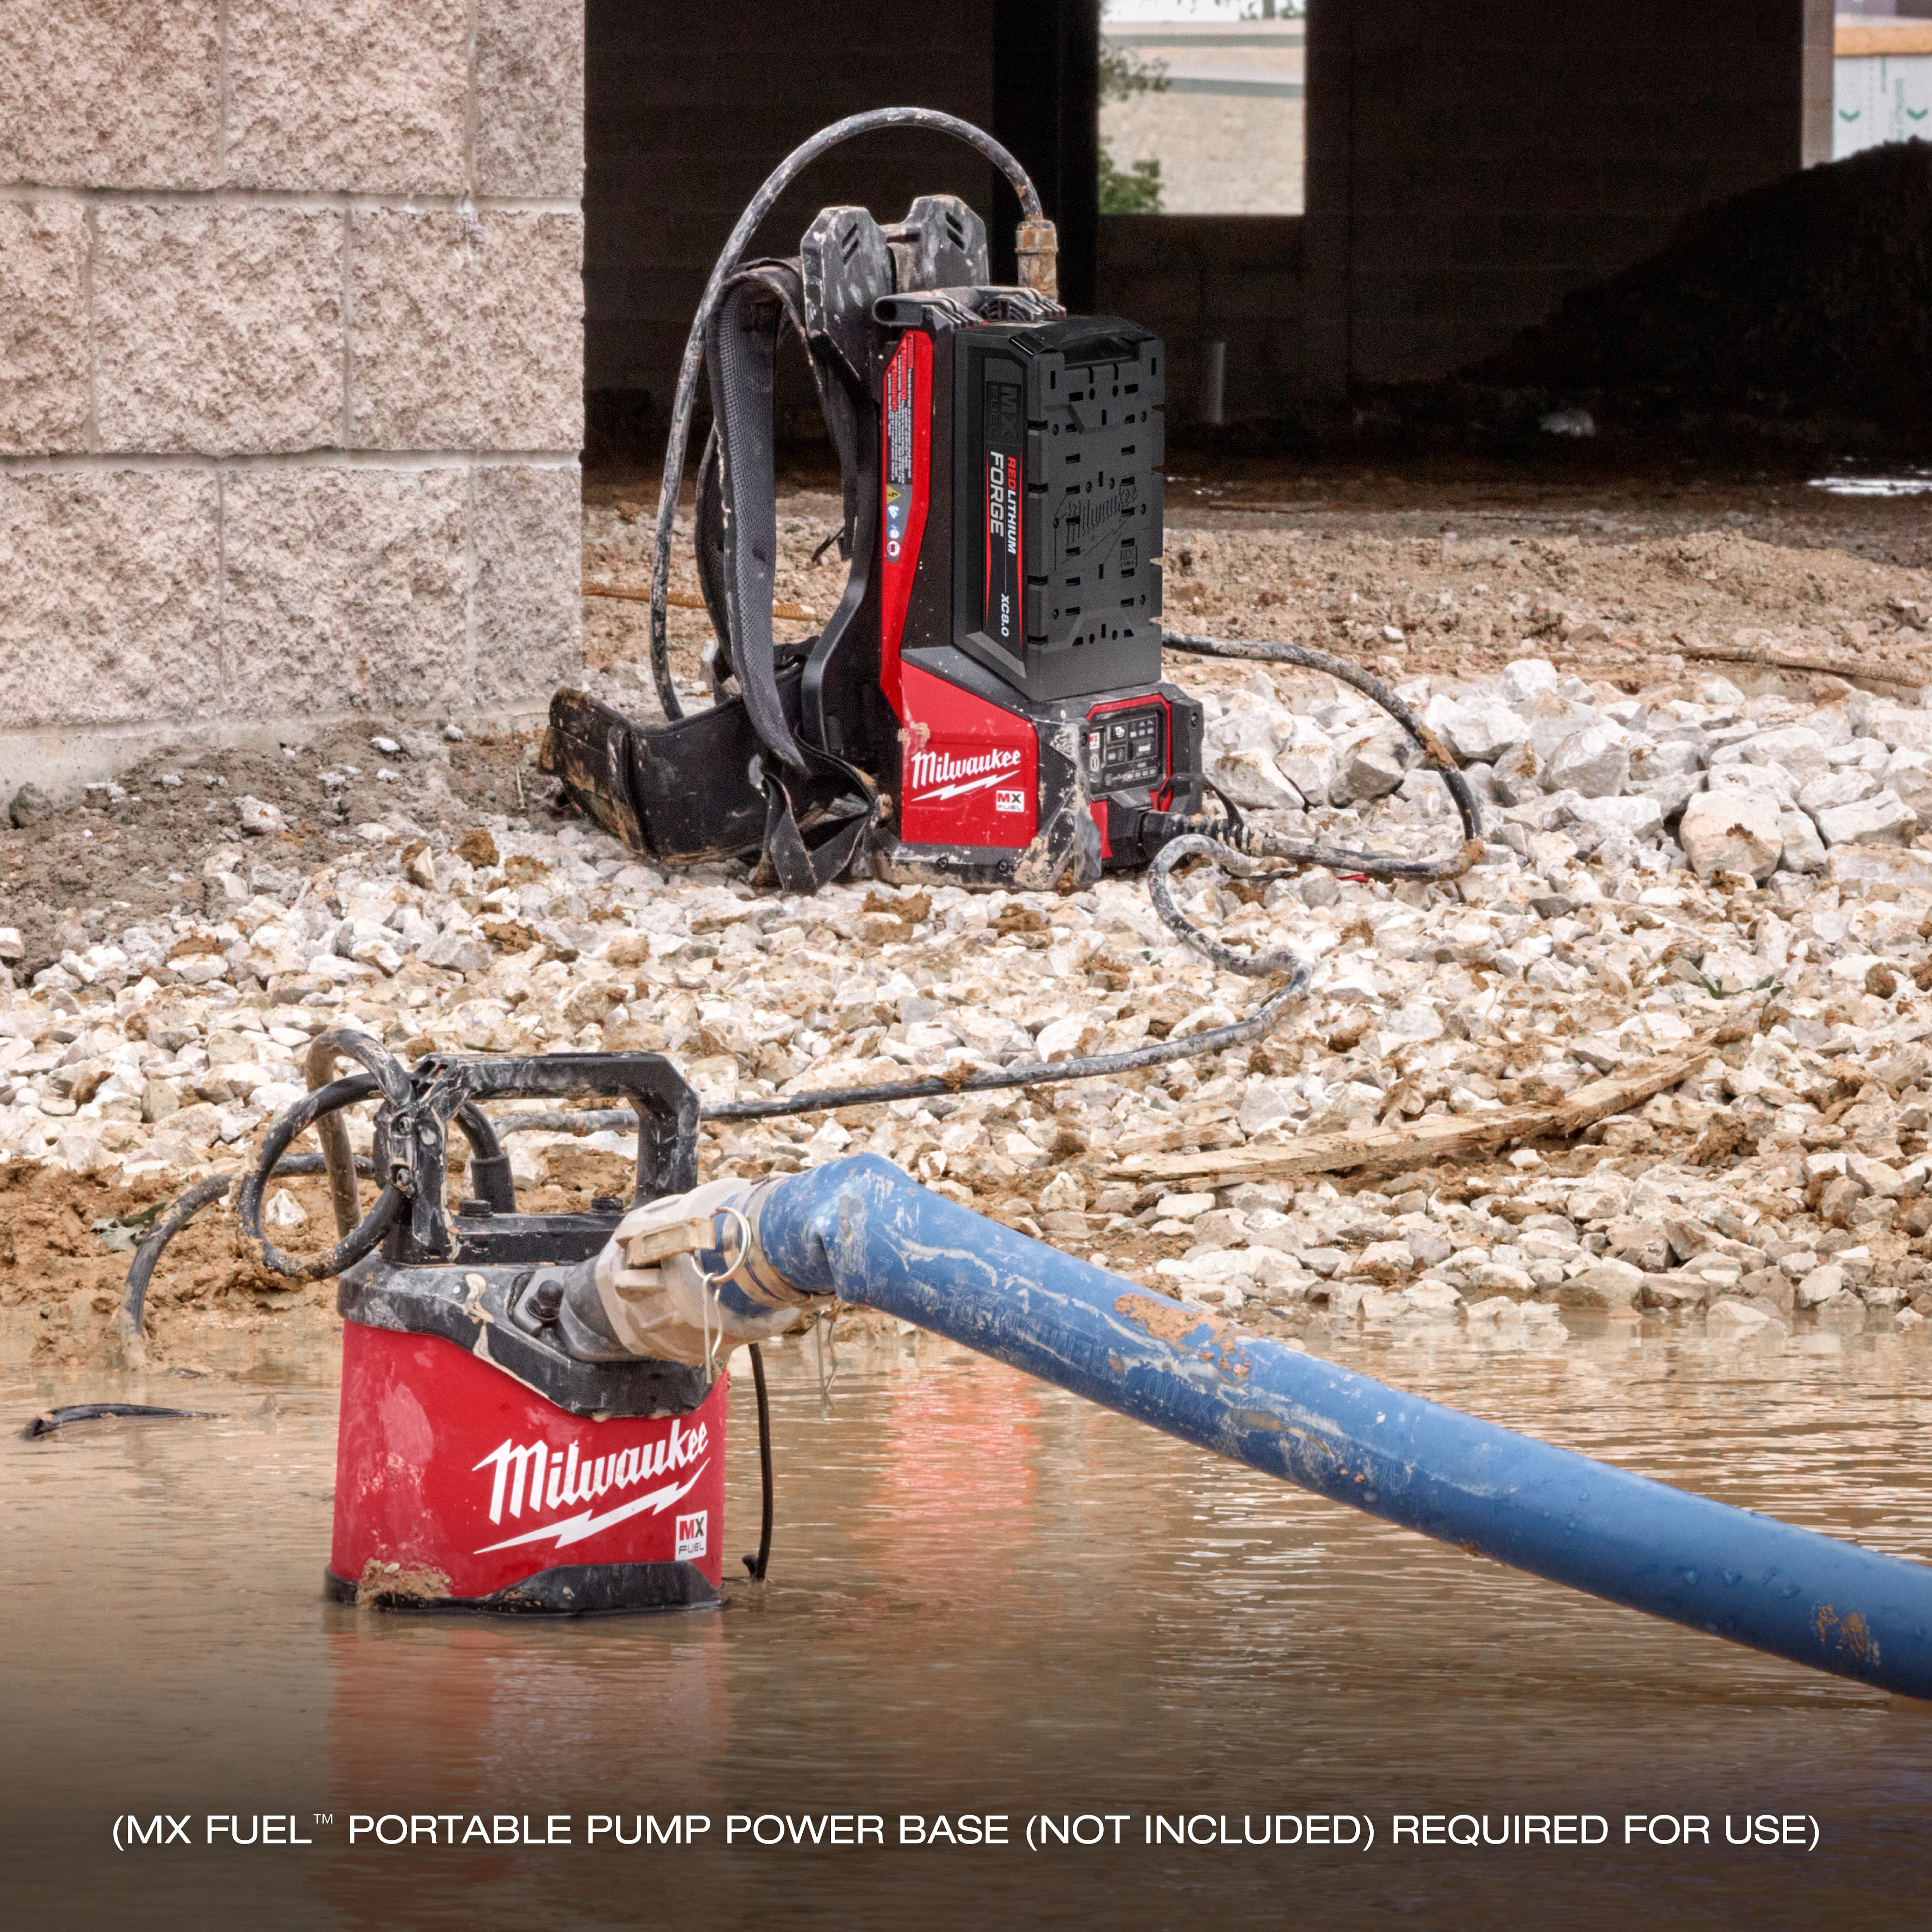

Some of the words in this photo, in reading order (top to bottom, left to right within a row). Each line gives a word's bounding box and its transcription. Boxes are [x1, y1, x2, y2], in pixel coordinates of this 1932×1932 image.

[1001, 386, 1017, 440] MX
[989, 451, 1004, 537] FORGE
[1007, 456, 1017, 554] REDLITHIUM
[1000, 594, 1010, 637] XC8.0
[911, 748, 1021, 790] Milwaukee
[997, 793, 1022, 803] MX
[472, 1419, 709, 1525] Milwaukee
[678, 1542, 704, 1555] FUEL
[679, 1517, 705, 1541] MX
